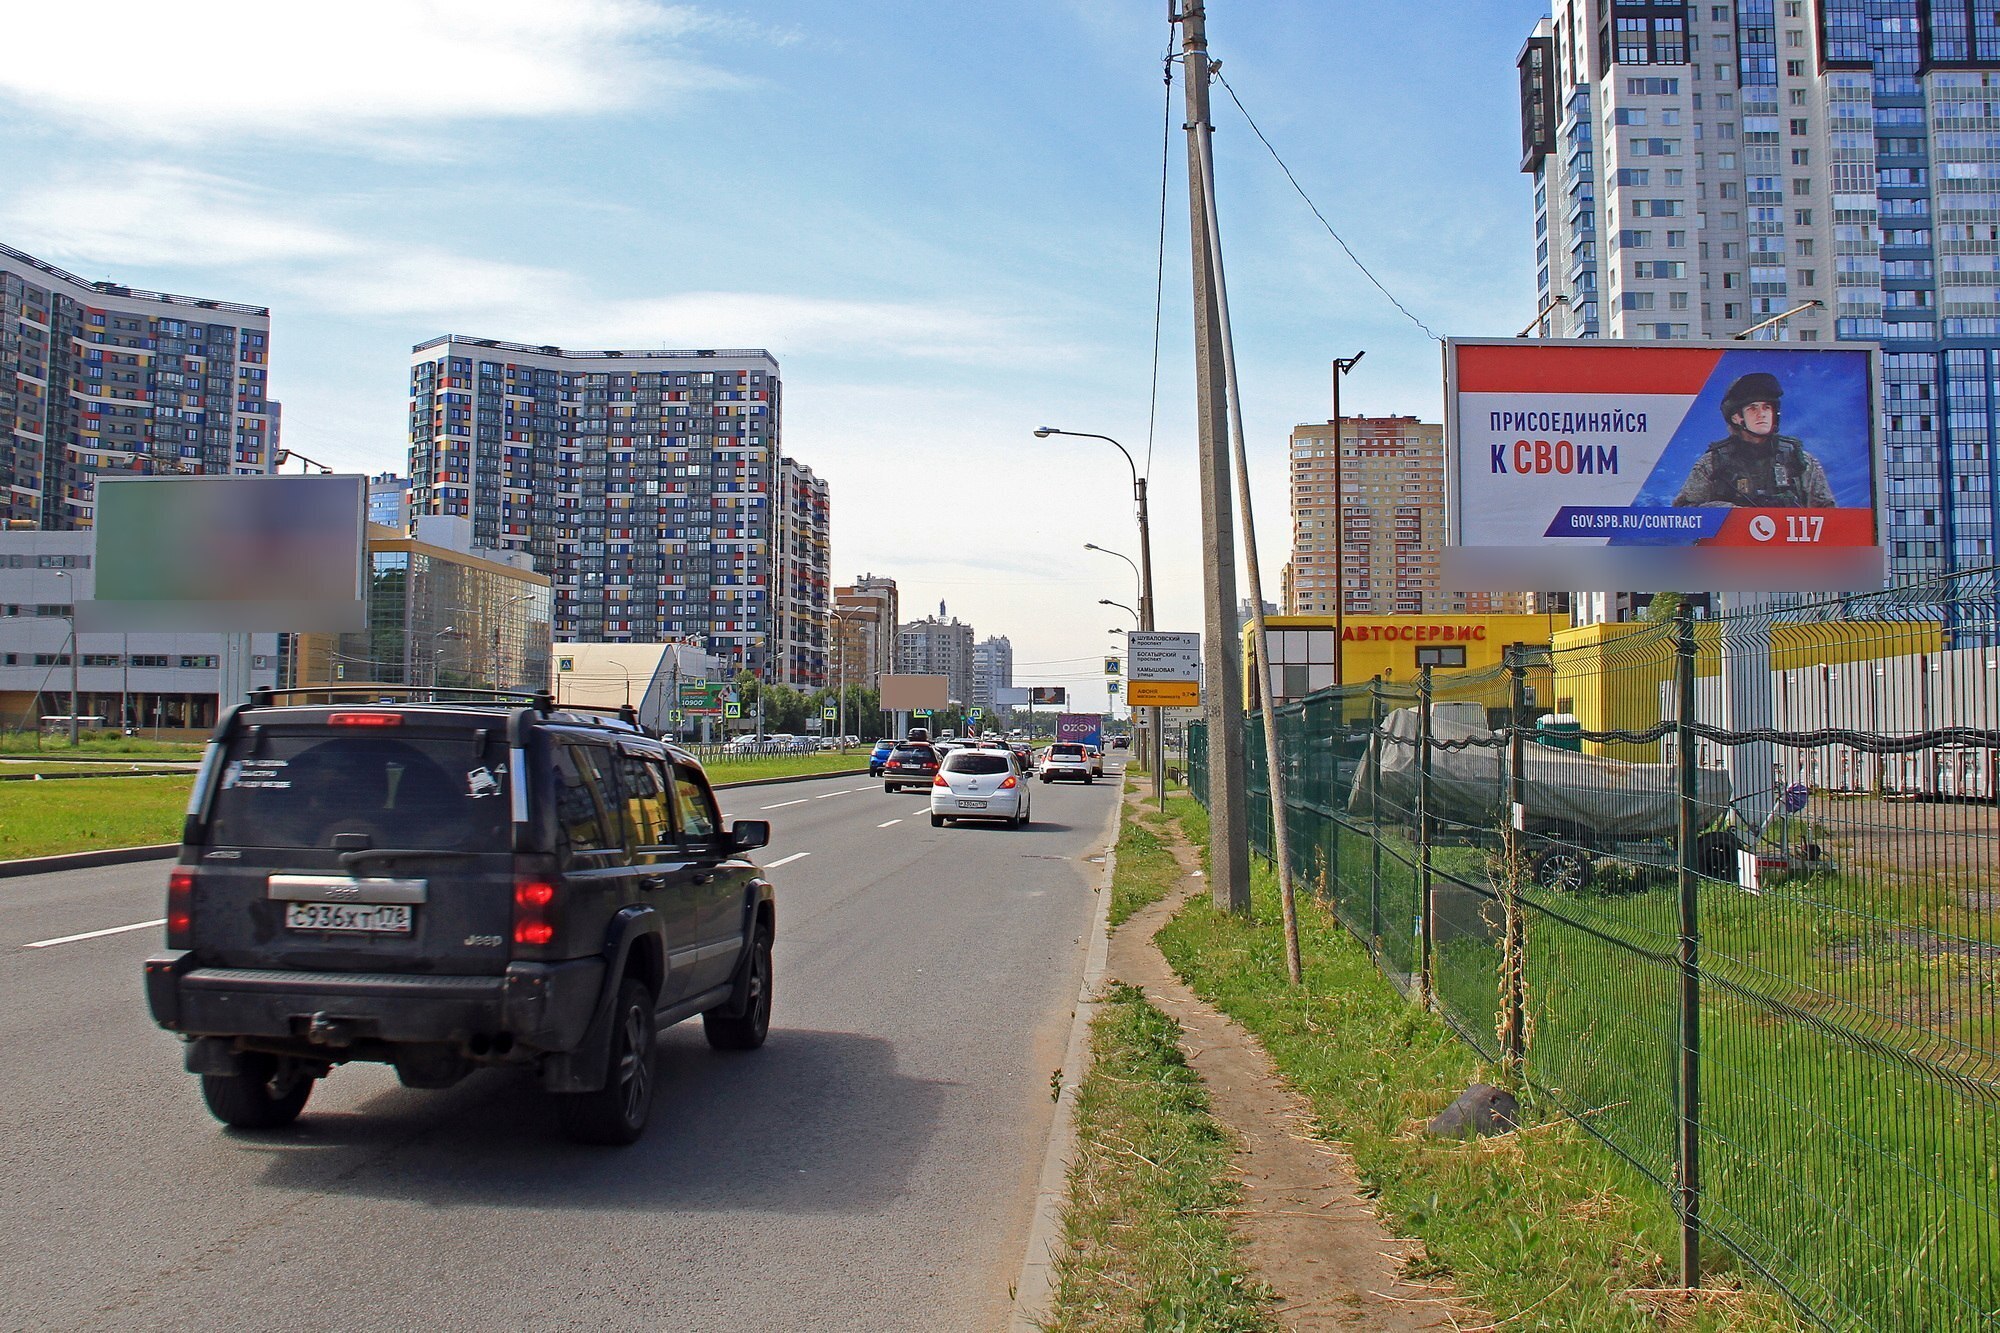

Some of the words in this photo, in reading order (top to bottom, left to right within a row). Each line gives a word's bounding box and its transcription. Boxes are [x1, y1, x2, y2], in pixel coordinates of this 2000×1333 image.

[1490, 409, 1647, 434] ПРИСОЕДИНЯЙСЯ
[1491, 445, 1507, 473] К
[1571, 515, 1702, 529] GOV.SPB.RU/CONTRACT
[1786, 516, 1824, 542] 117
[1341, 625, 1486, 641] АВТОСЕРВИС
[1062, 723, 1096, 732] OZON
[463, 934, 503, 948] Jeep
